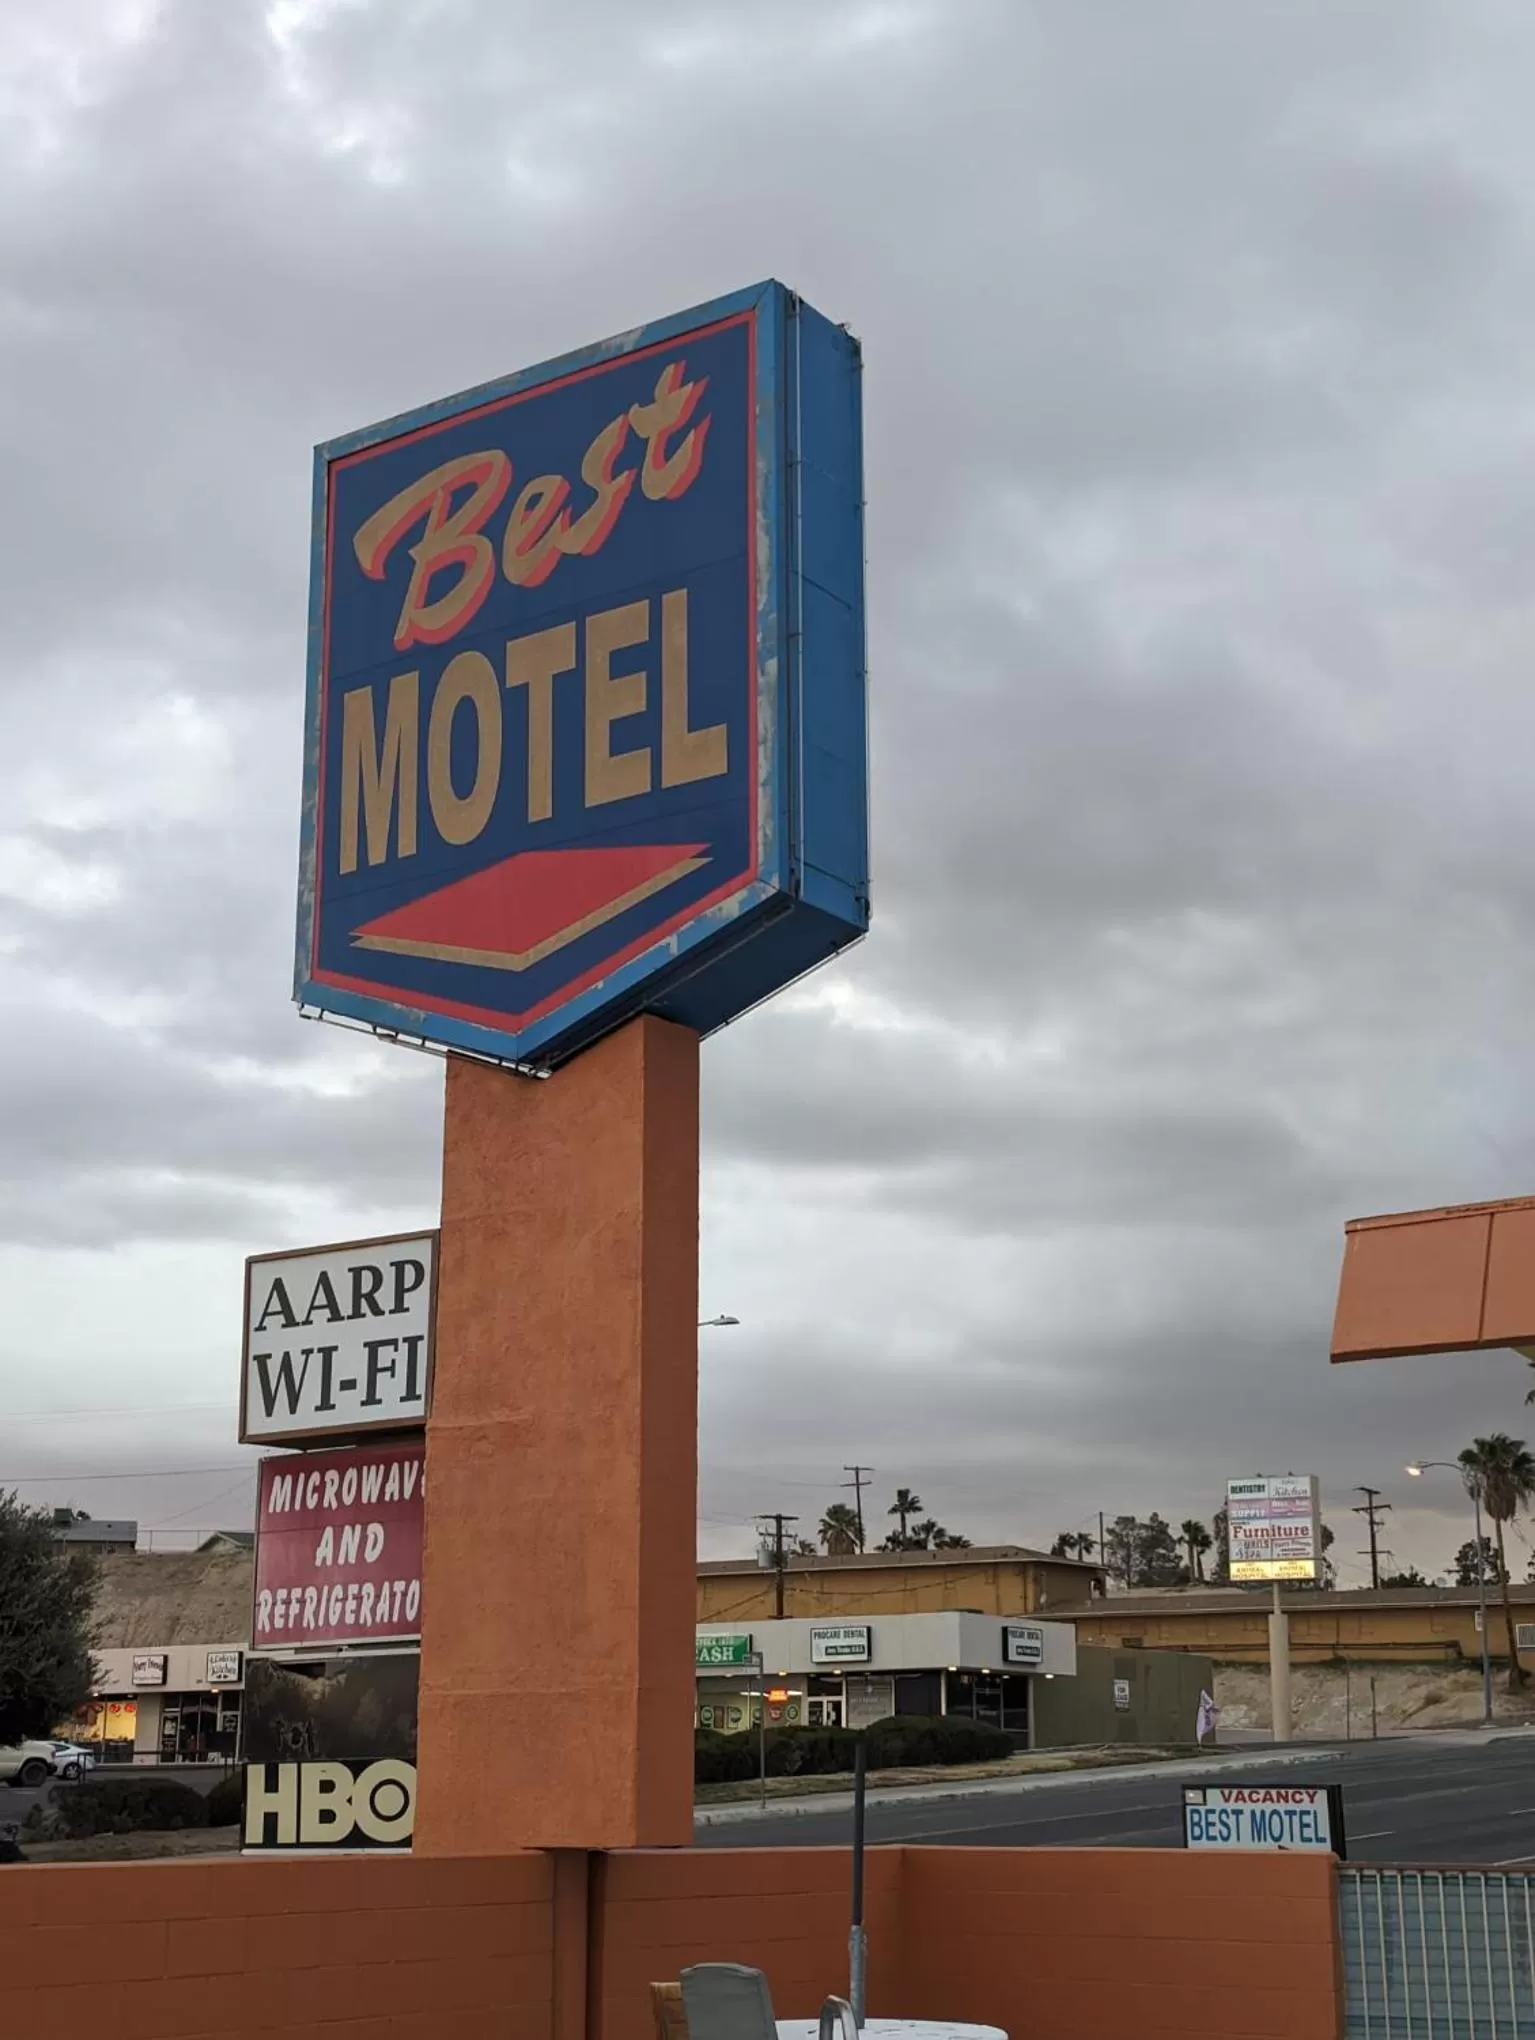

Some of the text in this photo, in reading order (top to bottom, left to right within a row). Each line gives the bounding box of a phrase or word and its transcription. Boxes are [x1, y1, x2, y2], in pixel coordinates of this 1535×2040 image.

[352, 360, 711, 650] Best
[338, 589, 729, 876] MOTEL
[254, 1259, 425, 1332] AARP
[253, 1335, 425, 1417] WI-FI
[268, 1459, 426, 1514] MICROWAV
[315, 1522, 384, 1567] AND
[1232, 1525, 1310, 1539] Furniture
[696, 1646, 735, 1662] ASH
[245, 1759, 417, 1844] HBO
[1220, 1790, 1319, 1804] VACANCY
[1189, 1808, 1327, 1843] BEST MOTEL
